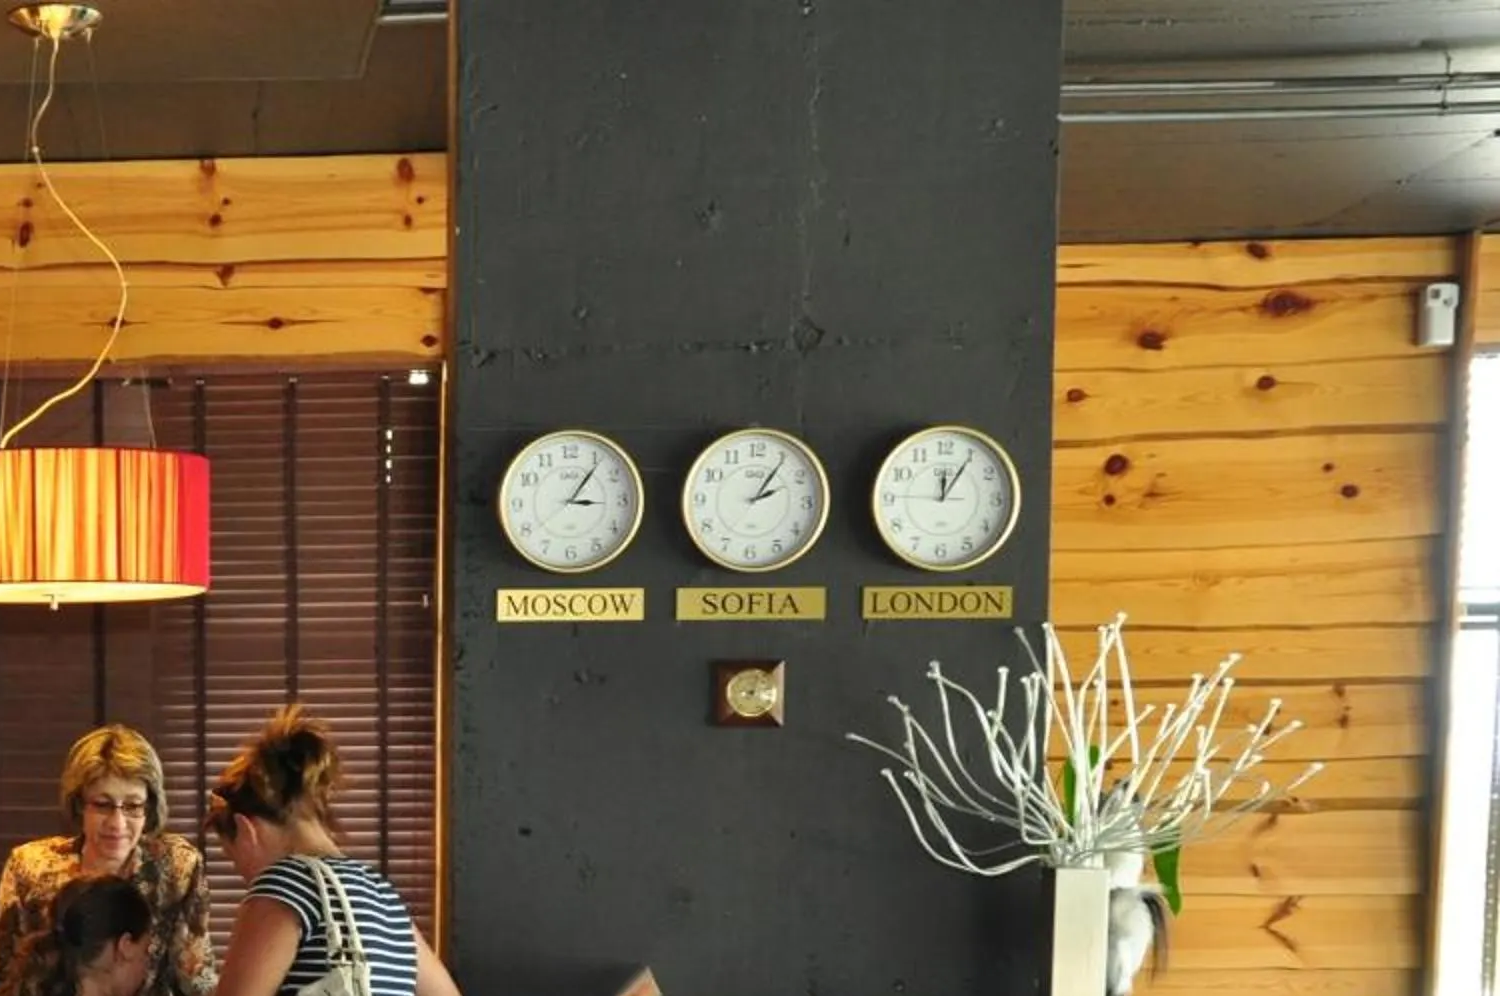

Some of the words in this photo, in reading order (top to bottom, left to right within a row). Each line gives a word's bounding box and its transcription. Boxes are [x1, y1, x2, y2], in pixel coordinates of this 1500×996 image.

[561, 445, 578, 459] 12
[750, 443, 766, 457] 12
[912, 448, 926, 462] 11
[937, 441, 954, 455] 12
[539, 453, 552, 467] 11
[724, 450, 739, 464] 11
[521, 472, 538, 487] 10
[608, 468, 619, 483] 2
[706, 468, 723, 482] 10
[794, 469, 805, 484] 2
[893, 467, 912, 481] 10
[983, 465, 995, 481] 2
[541, 540, 550, 554] 7
[590, 538, 602, 552] 5
[721, 537, 730, 551] 7
[772, 539, 782, 553] 5
[909, 536, 920, 550] 7
[934, 543, 946, 557] 6
[961, 536, 973, 550] 5
[565, 546, 577, 560] 6
[744, 545, 756, 559] 6
[506, 594, 636, 616] MOSCOW
[701, 592, 800, 615] SOFIA
[871, 591, 1004, 615] LONDON
